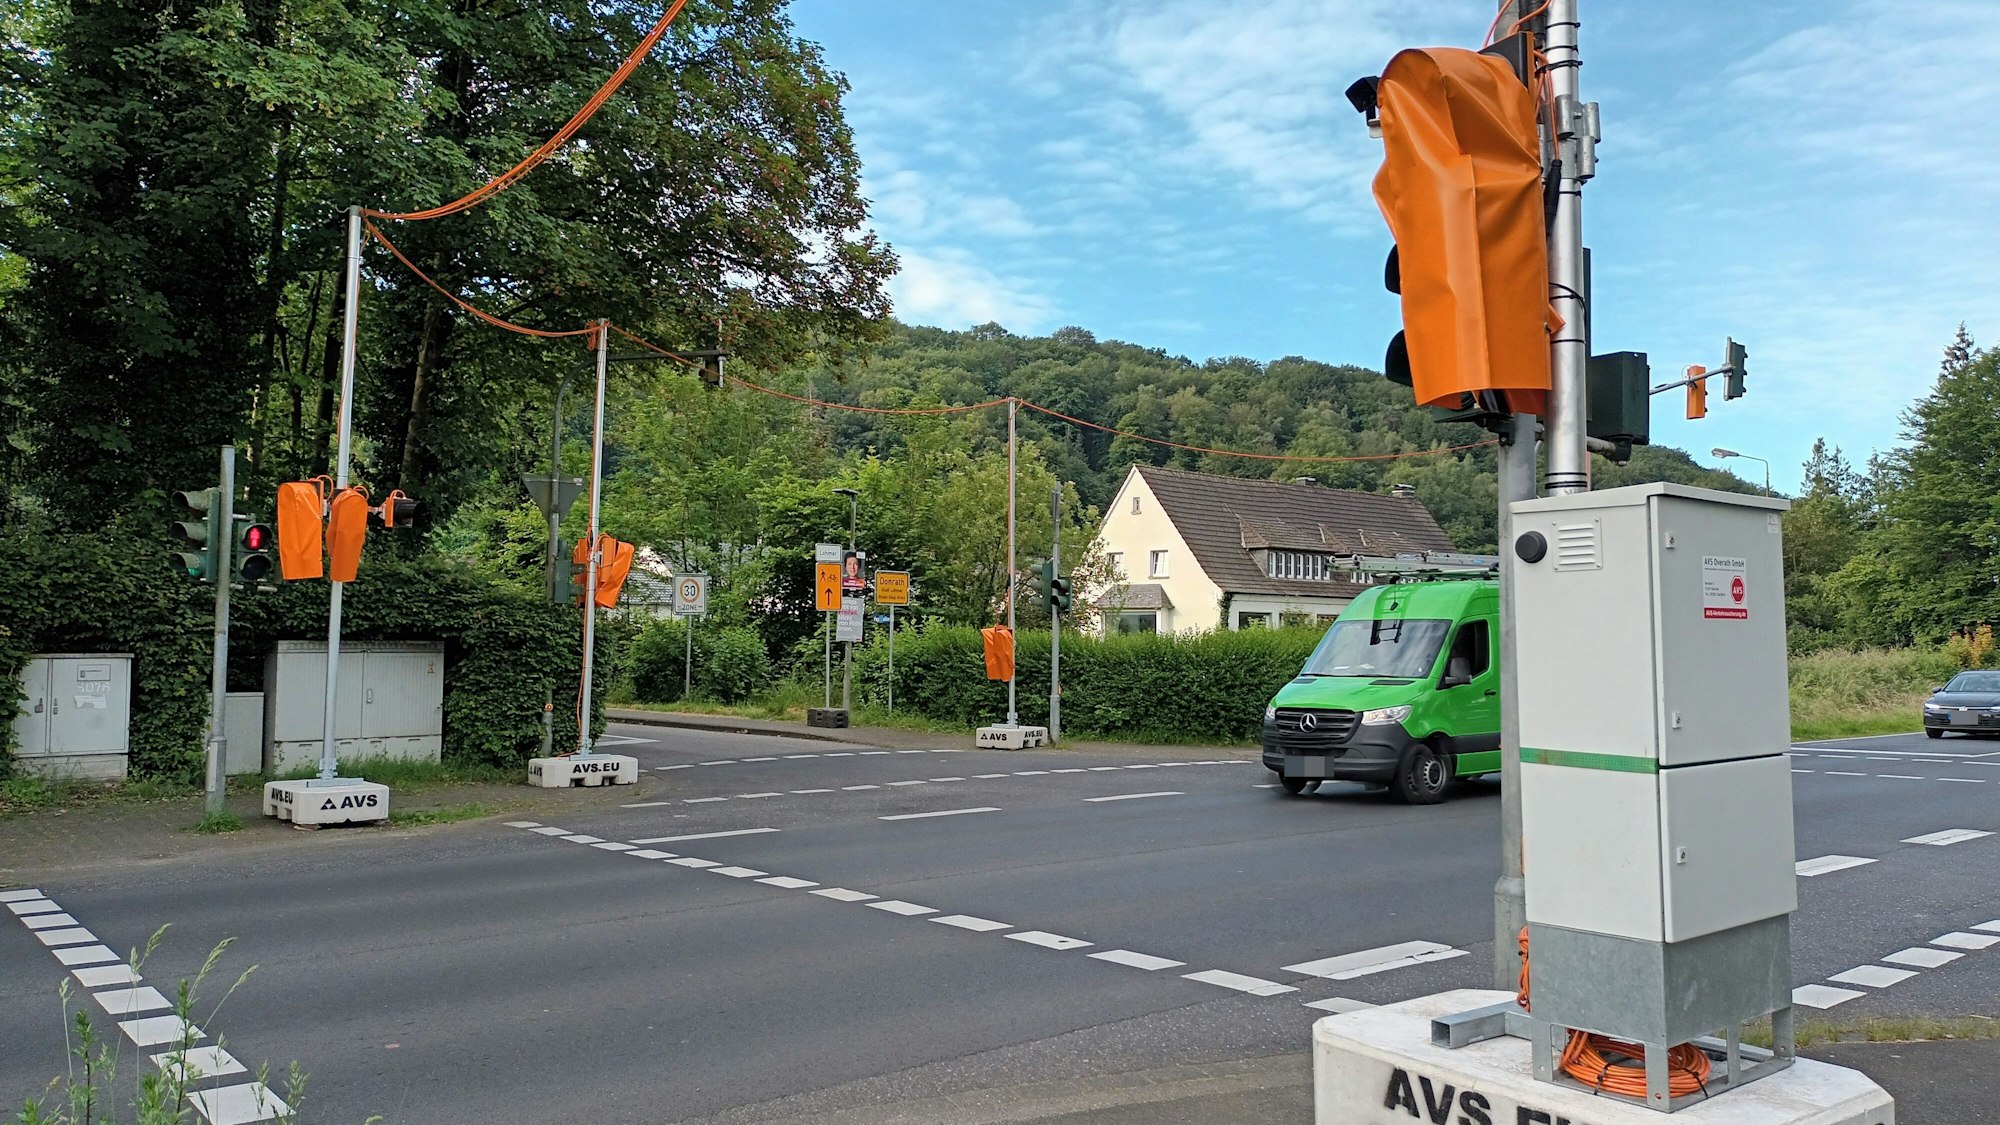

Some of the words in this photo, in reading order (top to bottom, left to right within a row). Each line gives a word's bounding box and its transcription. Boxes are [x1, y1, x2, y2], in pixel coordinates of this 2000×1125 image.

[1704, 558, 1713, 566] AVS
[1714, 558, 1731, 567] Overath
[1732, 559, 1744, 567] GmbH
[684, 585, 696, 597] 30
[1733, 586, 1743, 595] AVS
[989, 733, 1007, 741] AVS
[1024, 730, 1043, 739] AVS.EU
[572, 762, 620, 774] AVS.EU
[271, 787, 294, 805] AVS.EU
[340, 794, 378, 809] AVS
